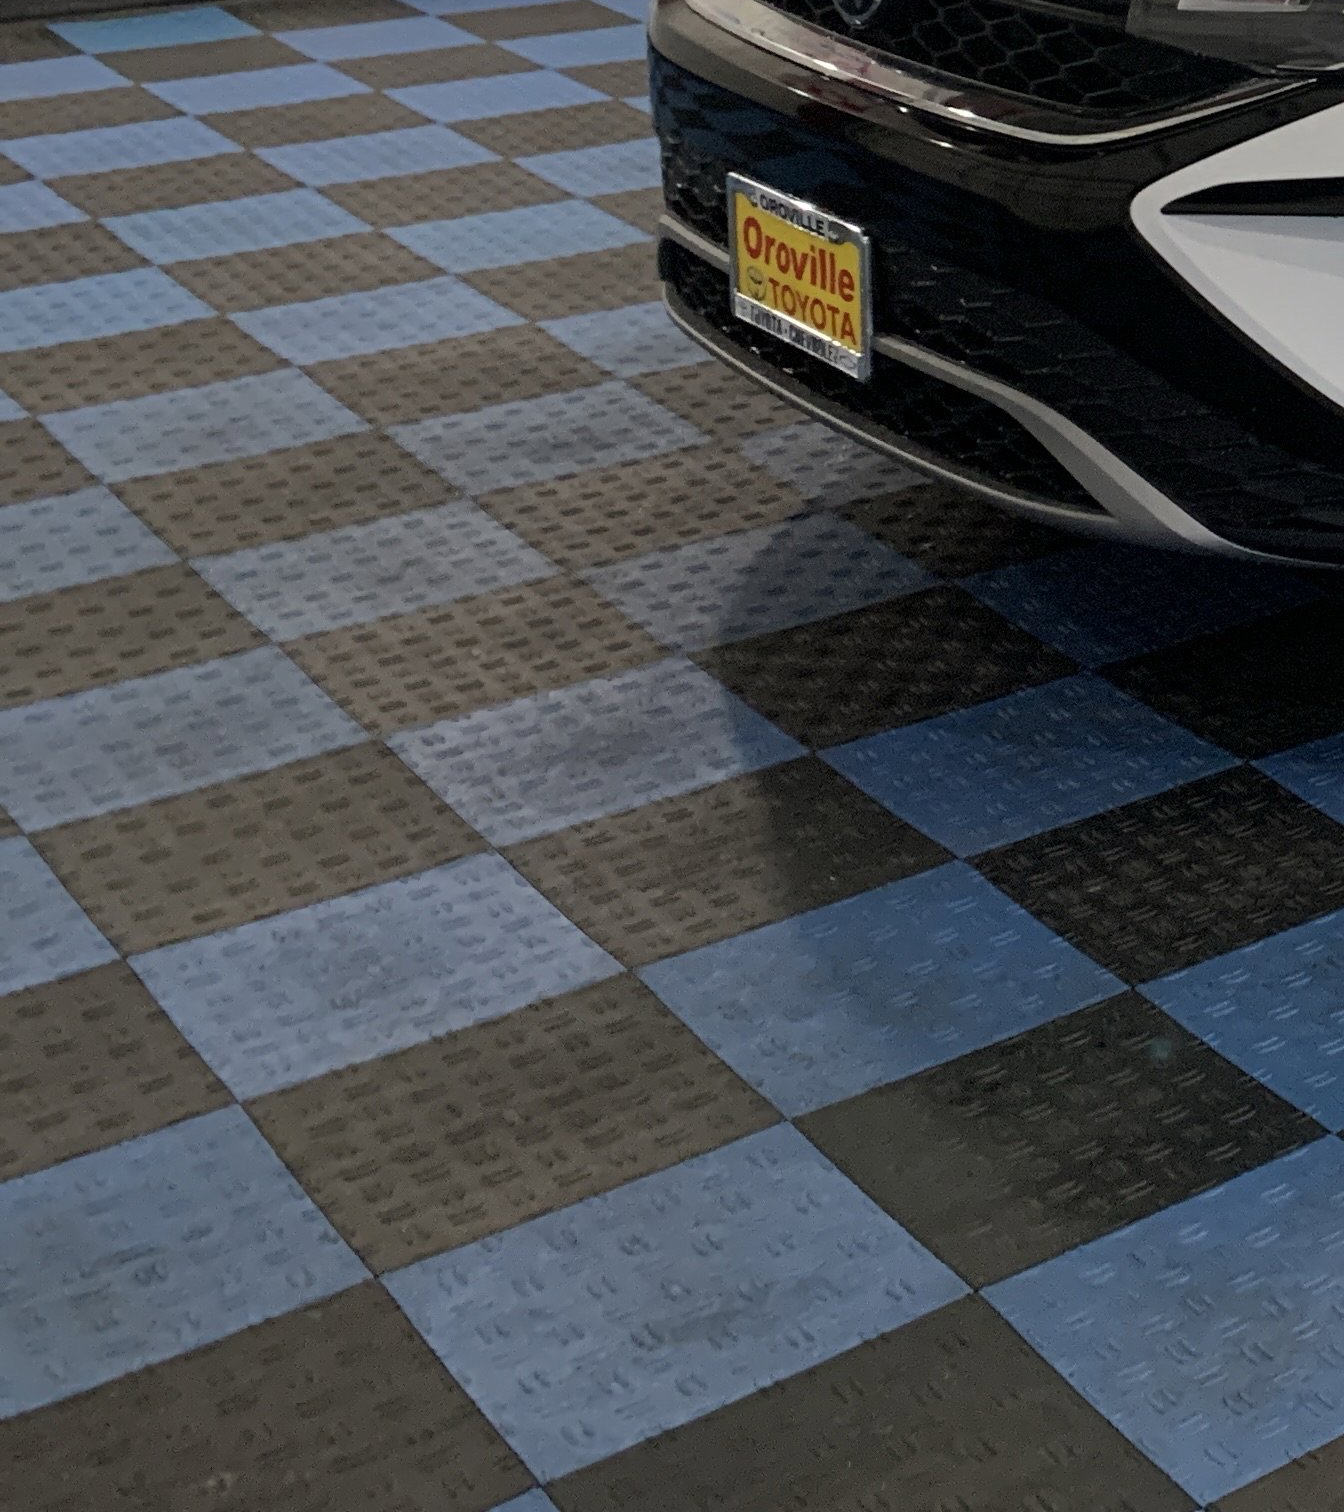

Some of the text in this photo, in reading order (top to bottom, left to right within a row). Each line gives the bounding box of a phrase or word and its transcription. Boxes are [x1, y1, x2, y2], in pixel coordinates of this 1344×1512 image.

[760, 194, 825, 237] OROVILLE
[743, 216, 855, 302] Oroville
[768, 277, 857, 345] TOYOTA
